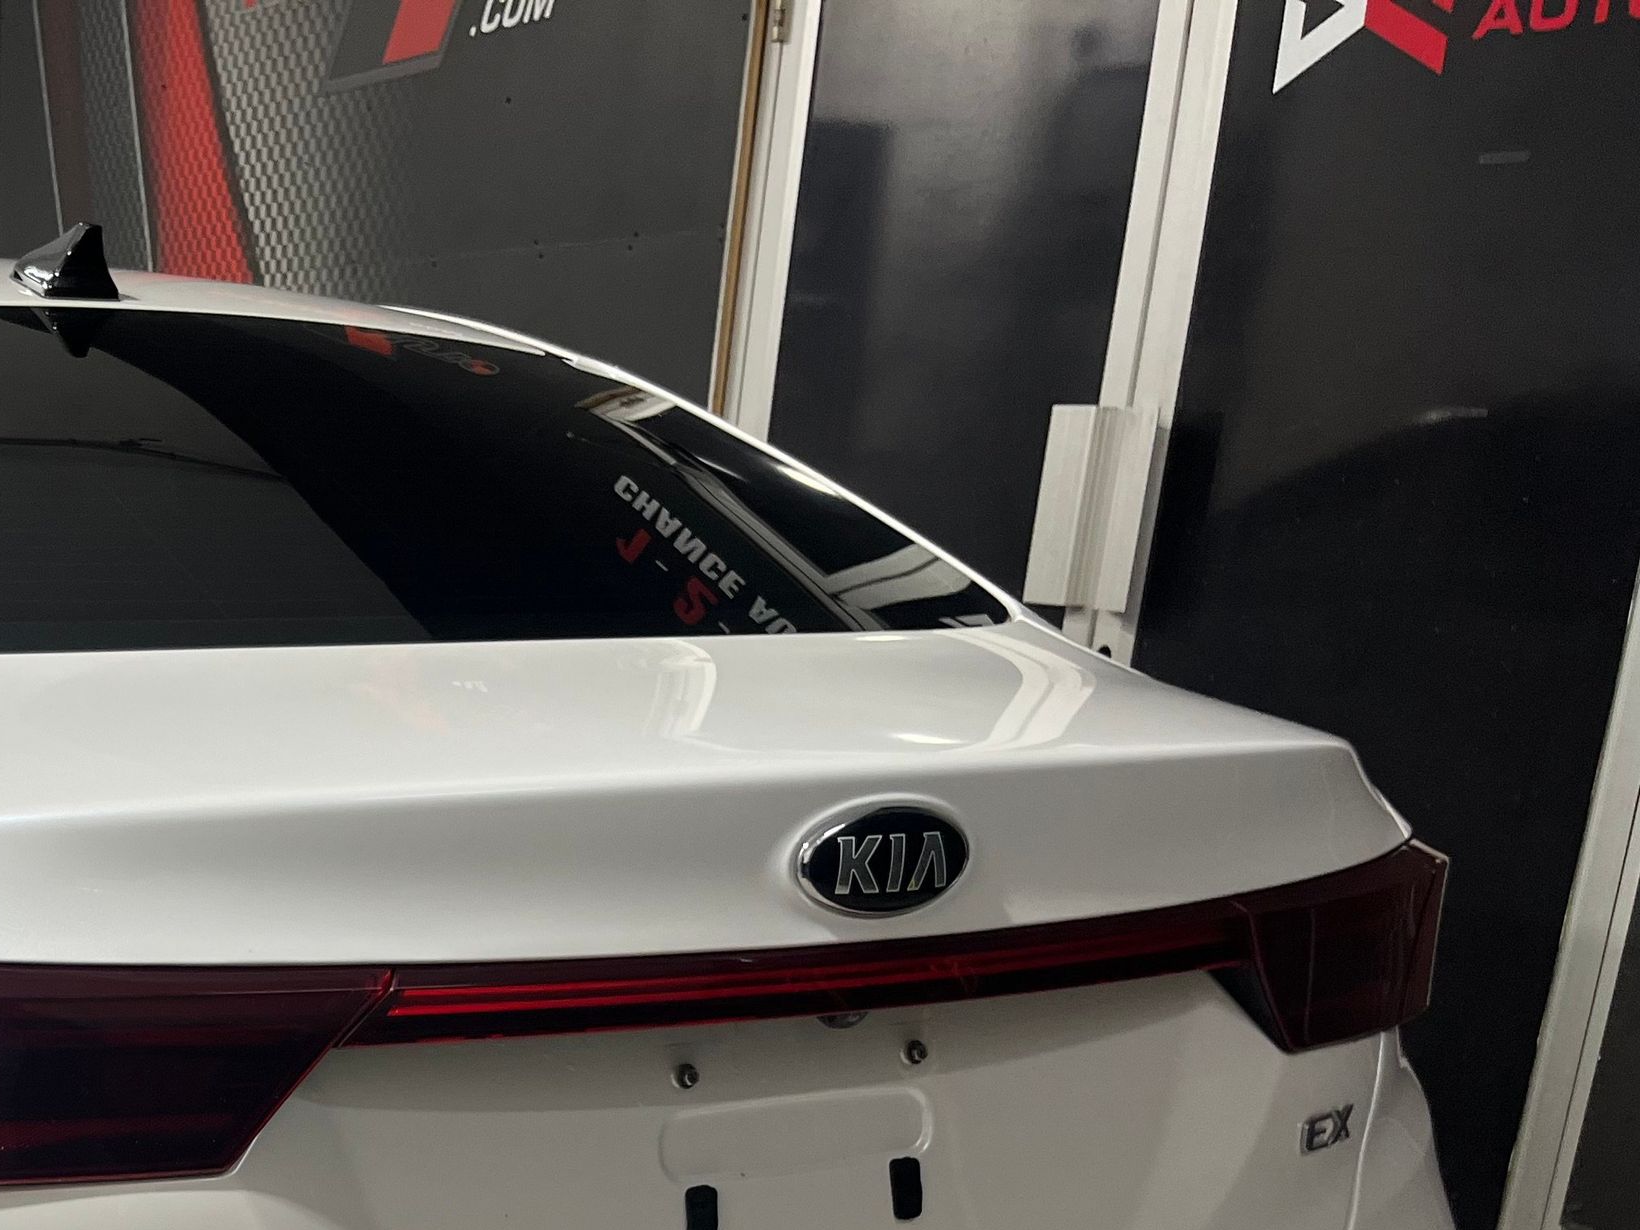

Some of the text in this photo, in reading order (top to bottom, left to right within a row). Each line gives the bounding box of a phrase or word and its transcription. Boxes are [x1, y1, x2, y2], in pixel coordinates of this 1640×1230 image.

[1470, 0, 1640, 39] AU
[834, 831, 947, 895] KIA
[1300, 1103, 1354, 1155] EX
